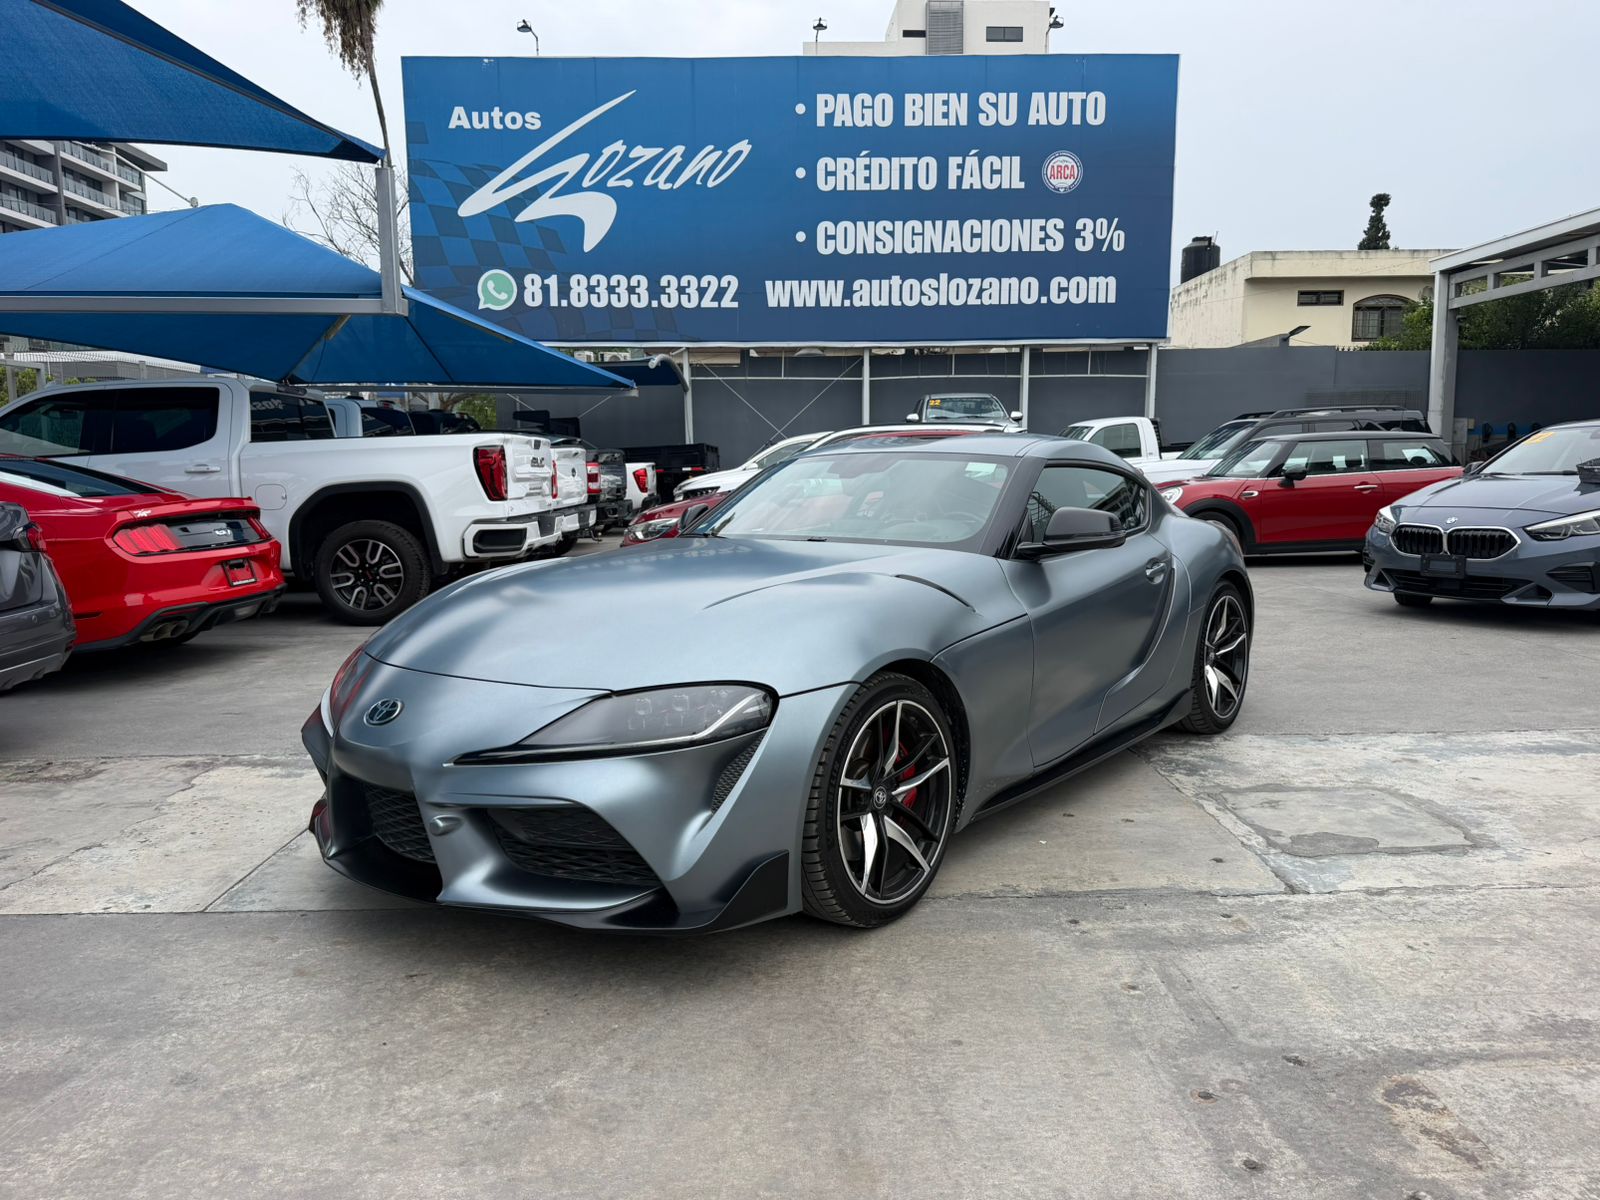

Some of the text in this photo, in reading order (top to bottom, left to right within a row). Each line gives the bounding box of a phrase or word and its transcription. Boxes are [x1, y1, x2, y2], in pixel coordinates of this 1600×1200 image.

[449, 106, 542, 130] Autos
[816, 90, 1107, 128] PAGO BIEN SU AUTO
[457, 89, 753, 253] Lozano
[816, 149, 1025, 192] CRÉDITO FÁCIL
[1049, 164, 1076, 180] ARCA
[816, 217, 1125, 255] CONSIGNACIONES 3%
[523, 273, 739, 309] 81.8333.3322
[764, 272, 1117, 308] www.autoslozano.com
